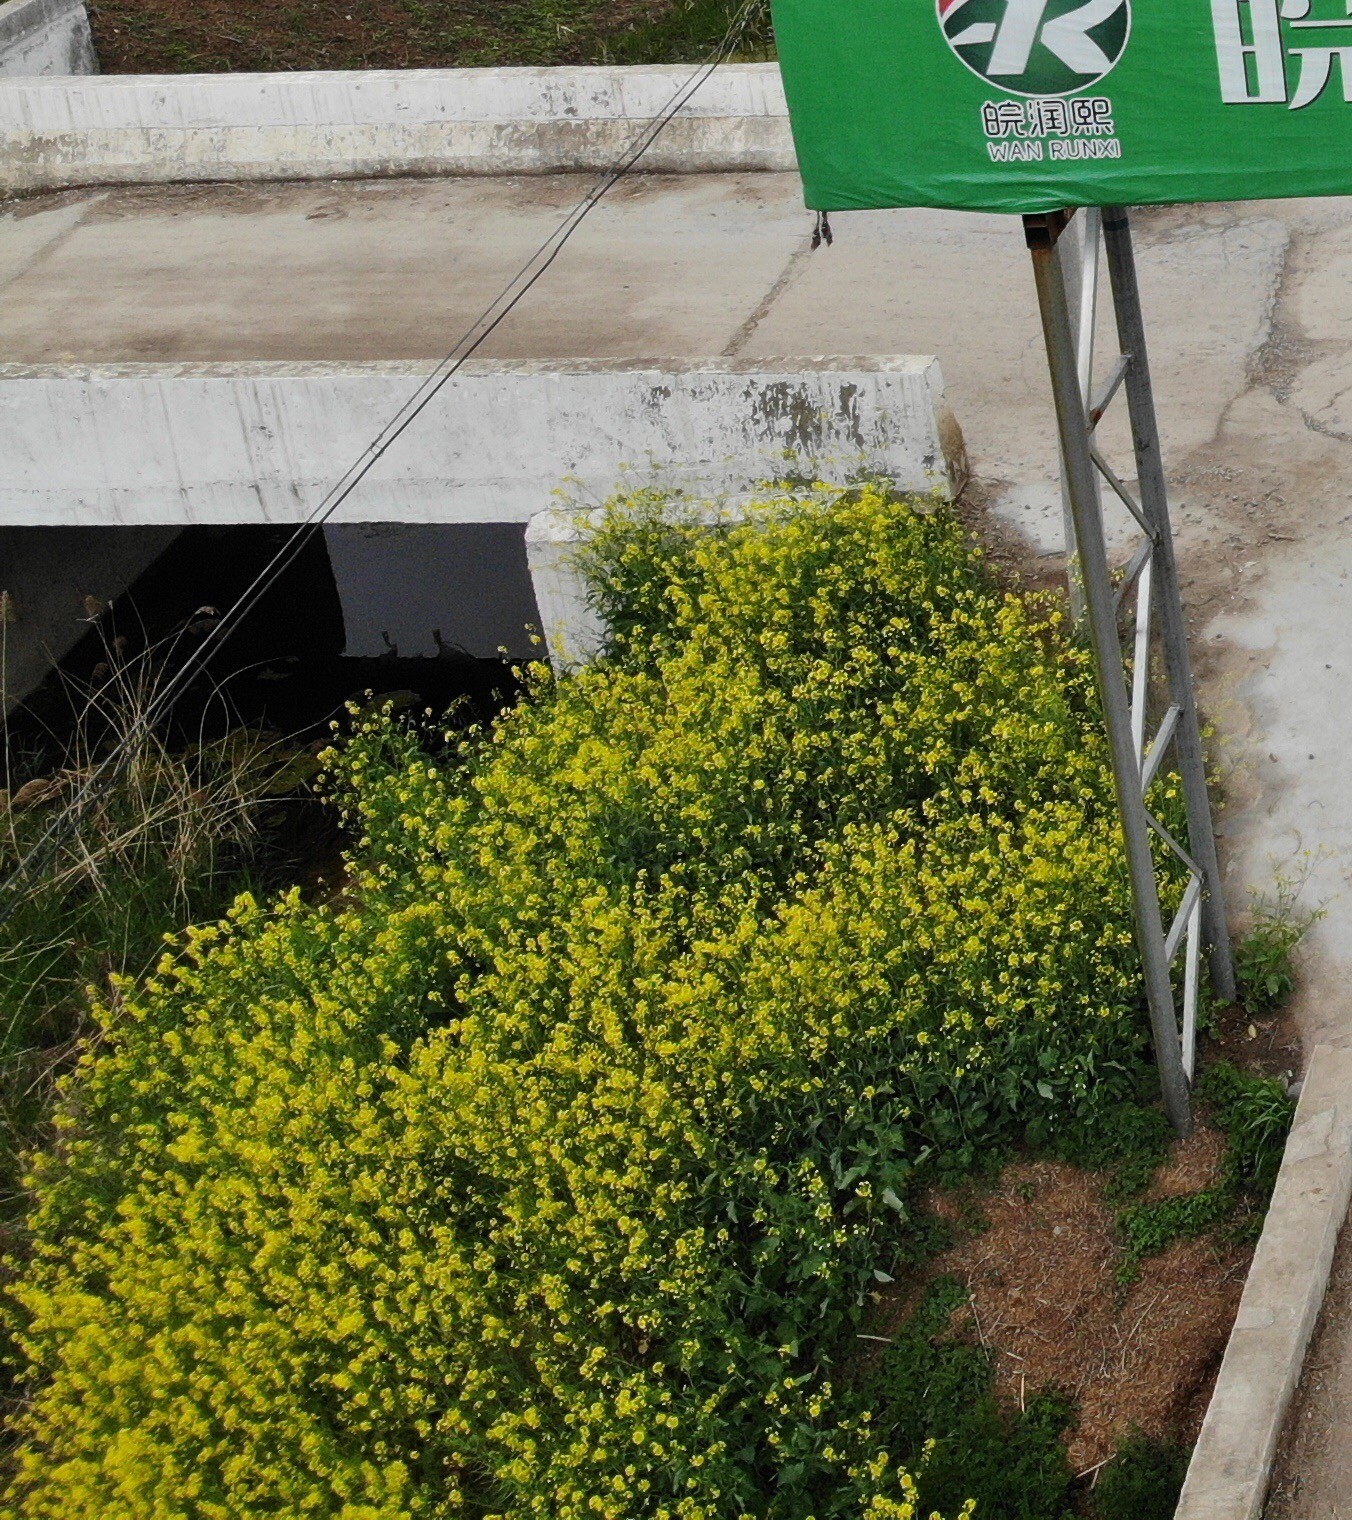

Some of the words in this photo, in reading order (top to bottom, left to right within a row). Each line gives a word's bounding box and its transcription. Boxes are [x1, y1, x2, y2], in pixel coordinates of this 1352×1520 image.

[981, 97, 1115, 138] 皖润熙
[987, 140, 1043, 163] WAN
[1050, 138, 1122, 161] RUNXI
